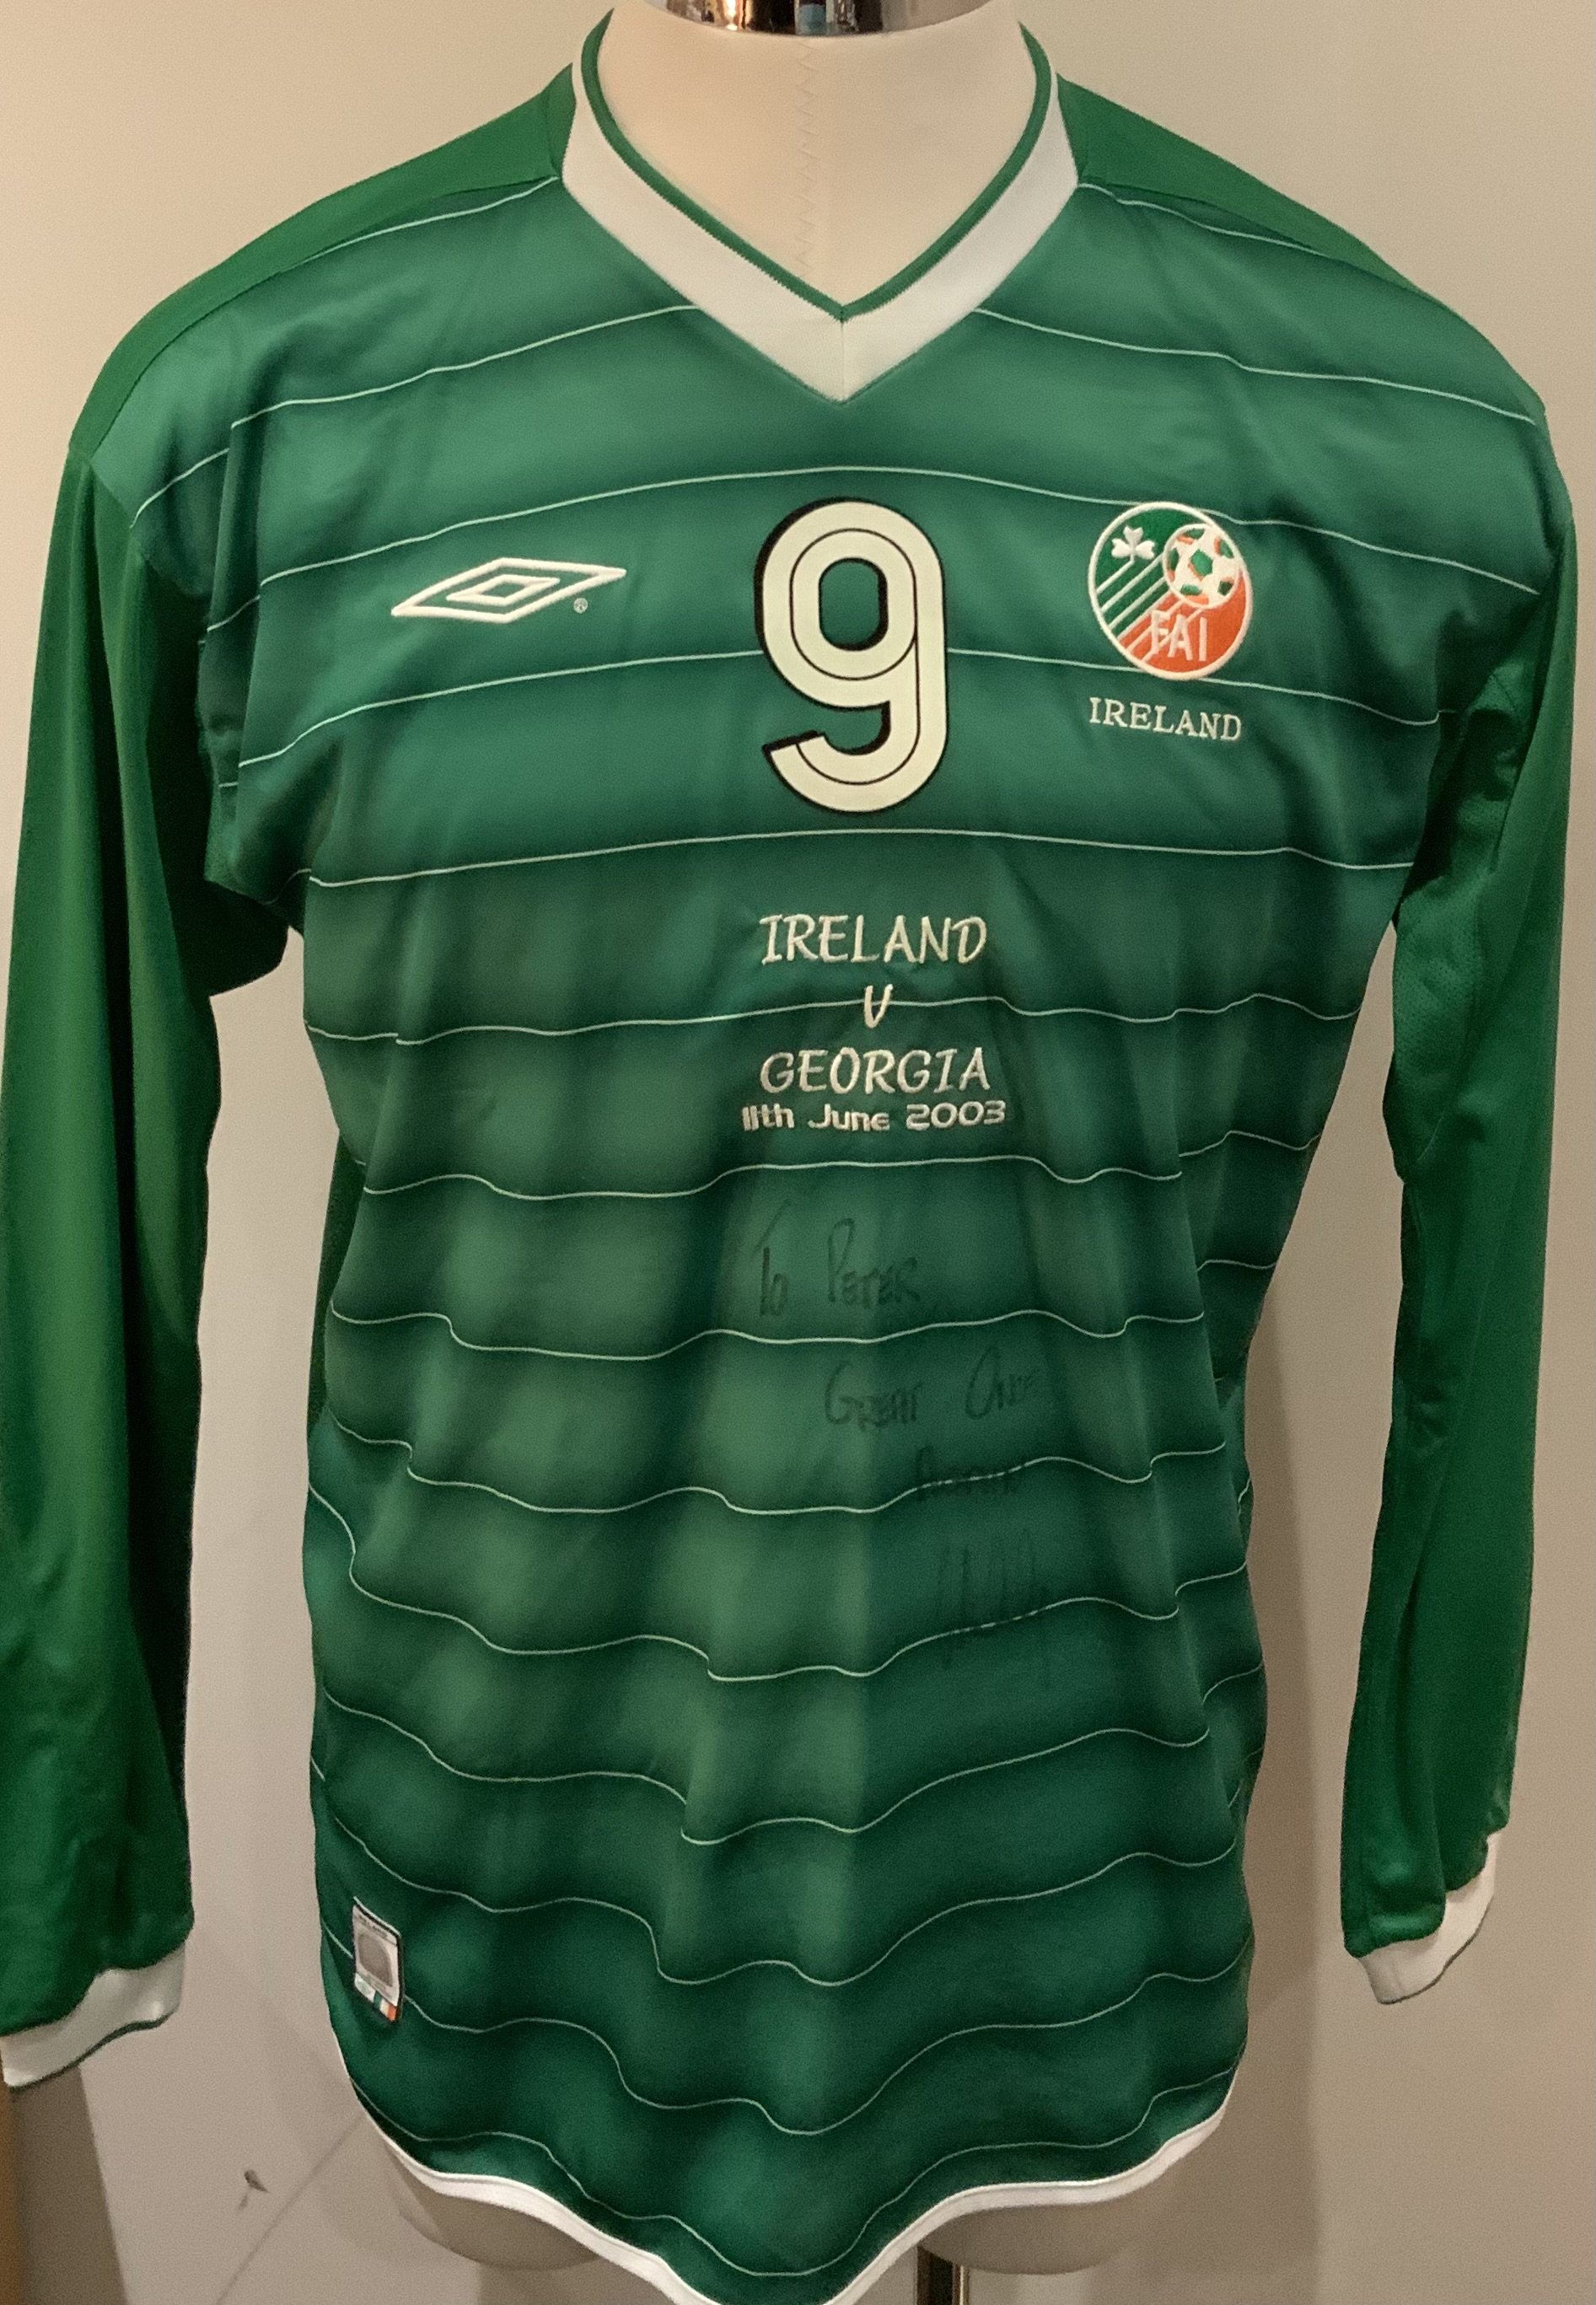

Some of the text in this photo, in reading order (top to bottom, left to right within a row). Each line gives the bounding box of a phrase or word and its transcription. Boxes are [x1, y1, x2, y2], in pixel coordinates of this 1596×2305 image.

[754, 497, 949, 815] 9
[1150, 610, 1207, 662] FAI
[1088, 696, 1243, 741] IRELAND
[759, 913, 987, 965] IRELAND
[760, 1046, 991, 1094] GEORGIA
[807, 1103, 890, 1131] June
[905, 1099, 1007, 1131] 2003
